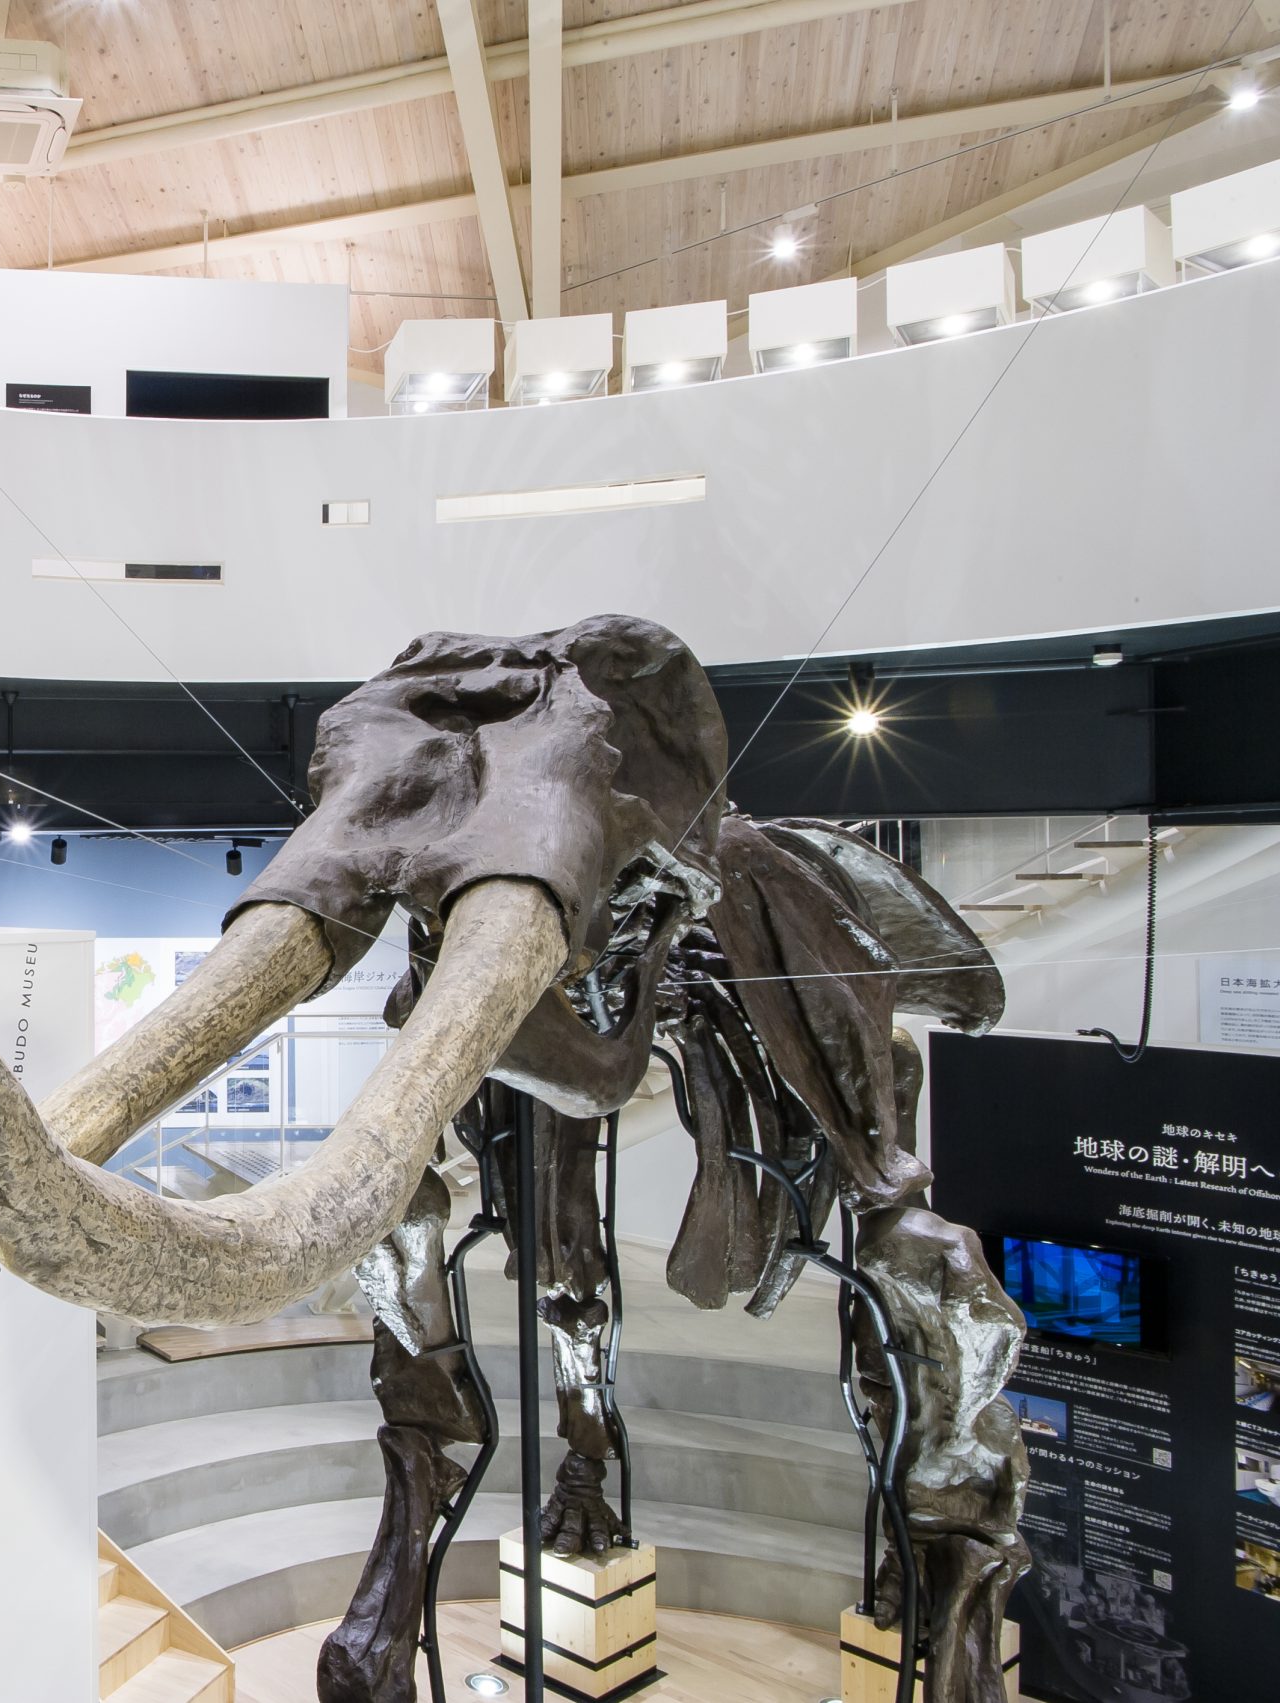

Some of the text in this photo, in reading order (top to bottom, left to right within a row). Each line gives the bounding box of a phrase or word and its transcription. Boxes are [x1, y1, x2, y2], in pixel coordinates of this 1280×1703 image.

[13, 1018, 29, 1075] BUDO
[21, 943, 39, 1008] MUSEU
[1161, 1123, 1238, 1143] 地球のキセキ
[1083, 1165, 1119, 1177] Wonders
[1121, 1170, 1131, 1178] of
[1131, 1171, 1143, 1180] the
[1145, 1173, 1168, 1184] Earth
[1174, 1177, 1199, 1188] Latest
[1200, 1181, 1237, 1194] Research
[1238, 1187, 1248, 1195] of
[1234, 1265, 1280, 1284] 「ちきゅう
[1234, 1328, 1280, 1344] コアカッティング
